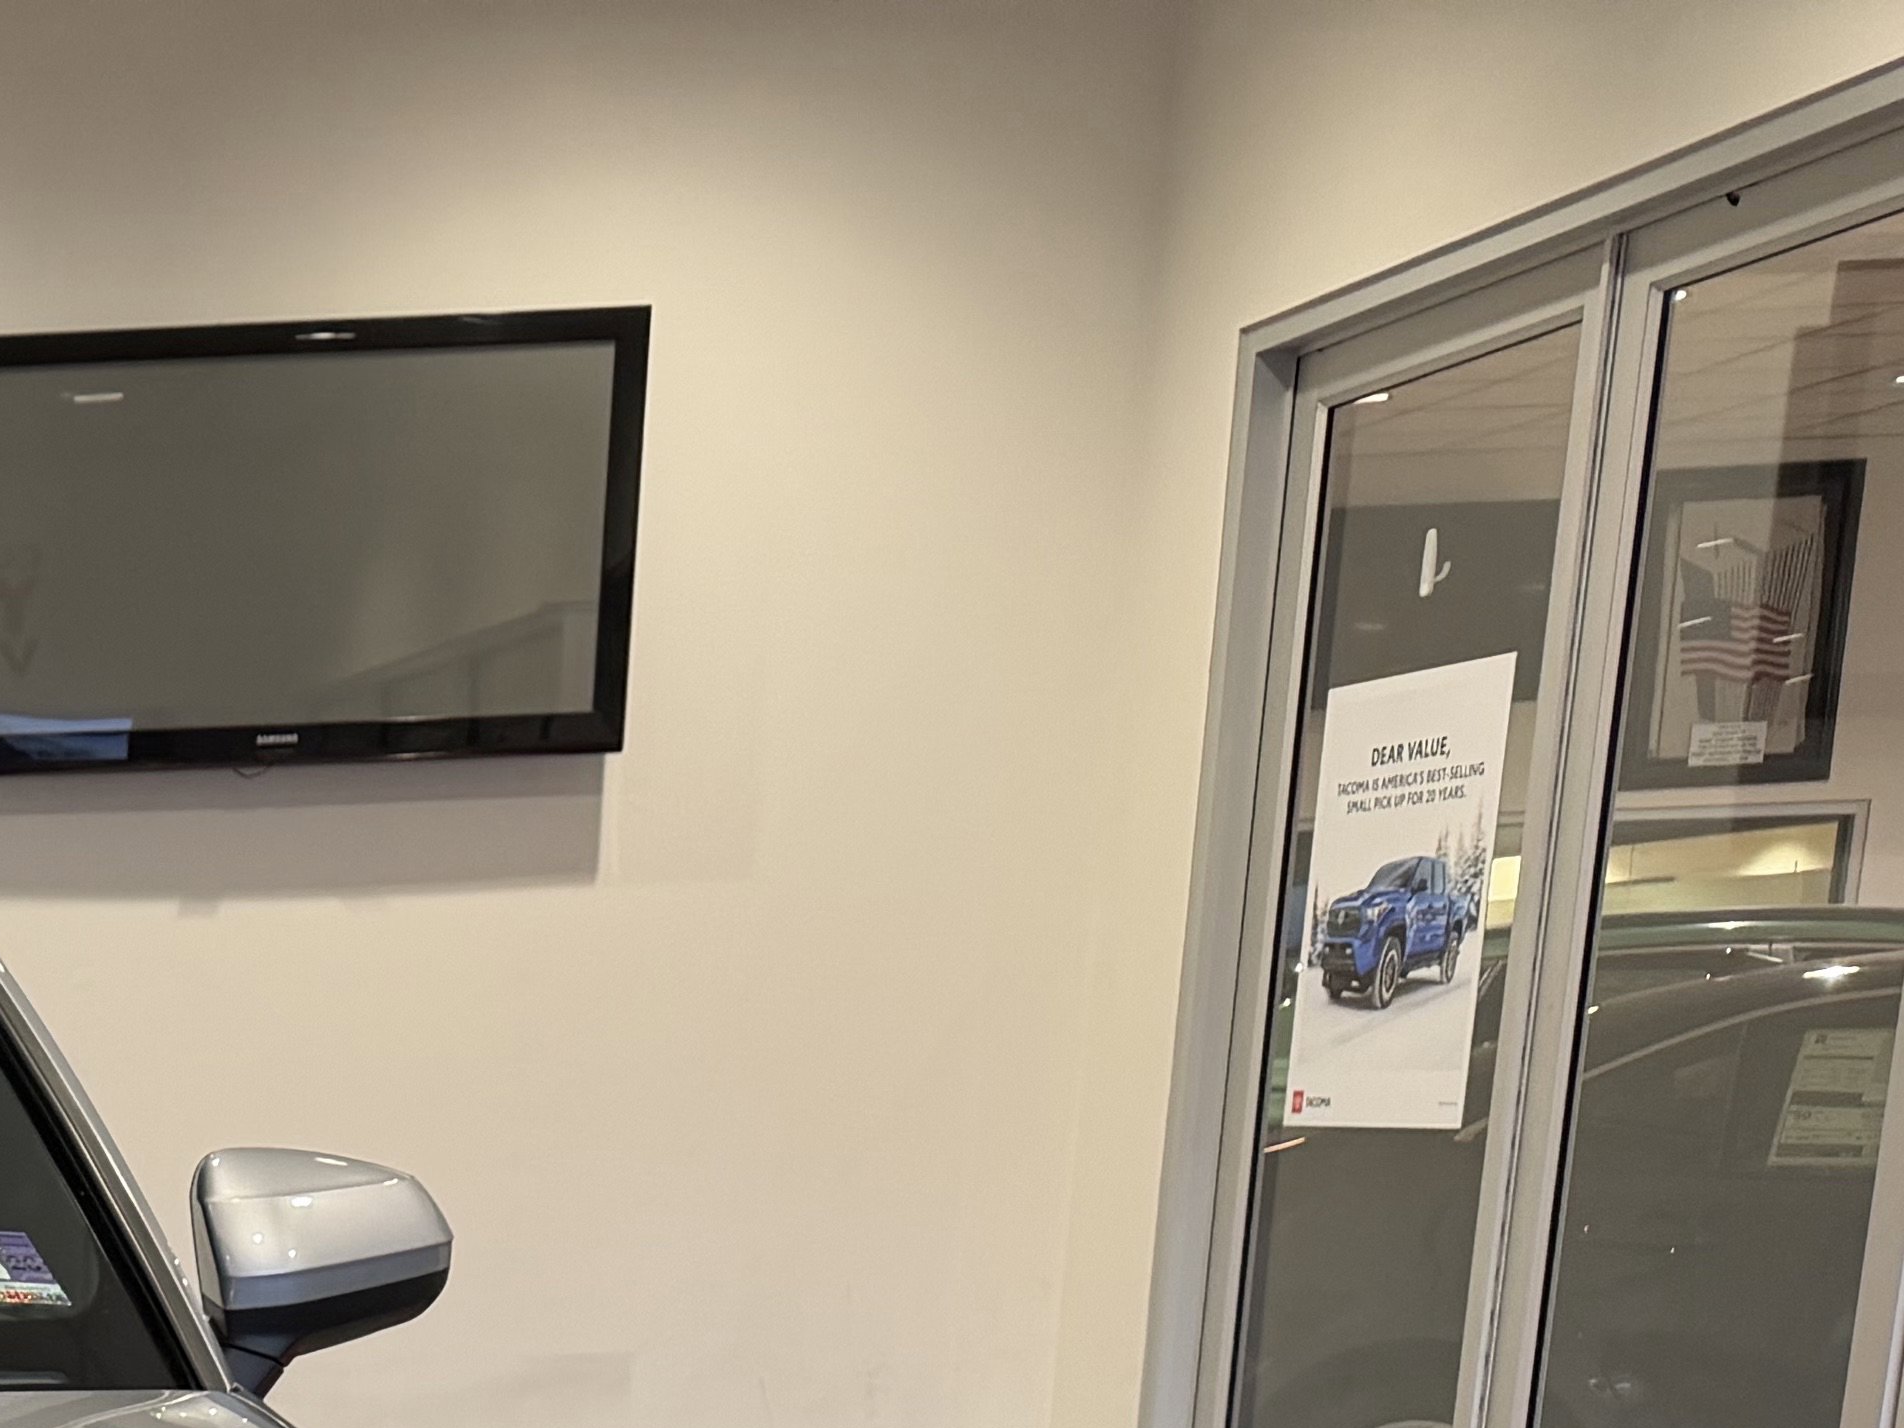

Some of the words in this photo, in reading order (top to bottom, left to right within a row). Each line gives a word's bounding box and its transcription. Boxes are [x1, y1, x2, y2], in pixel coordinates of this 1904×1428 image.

[1371, 743, 1404, 767] DEAR
[1408, 736, 1451, 762] VALUE,
[1337, 779, 1370, 797] TACOMA
[1346, 798, 1372, 815] SMALL
[1407, 790, 1424, 806] FOR
